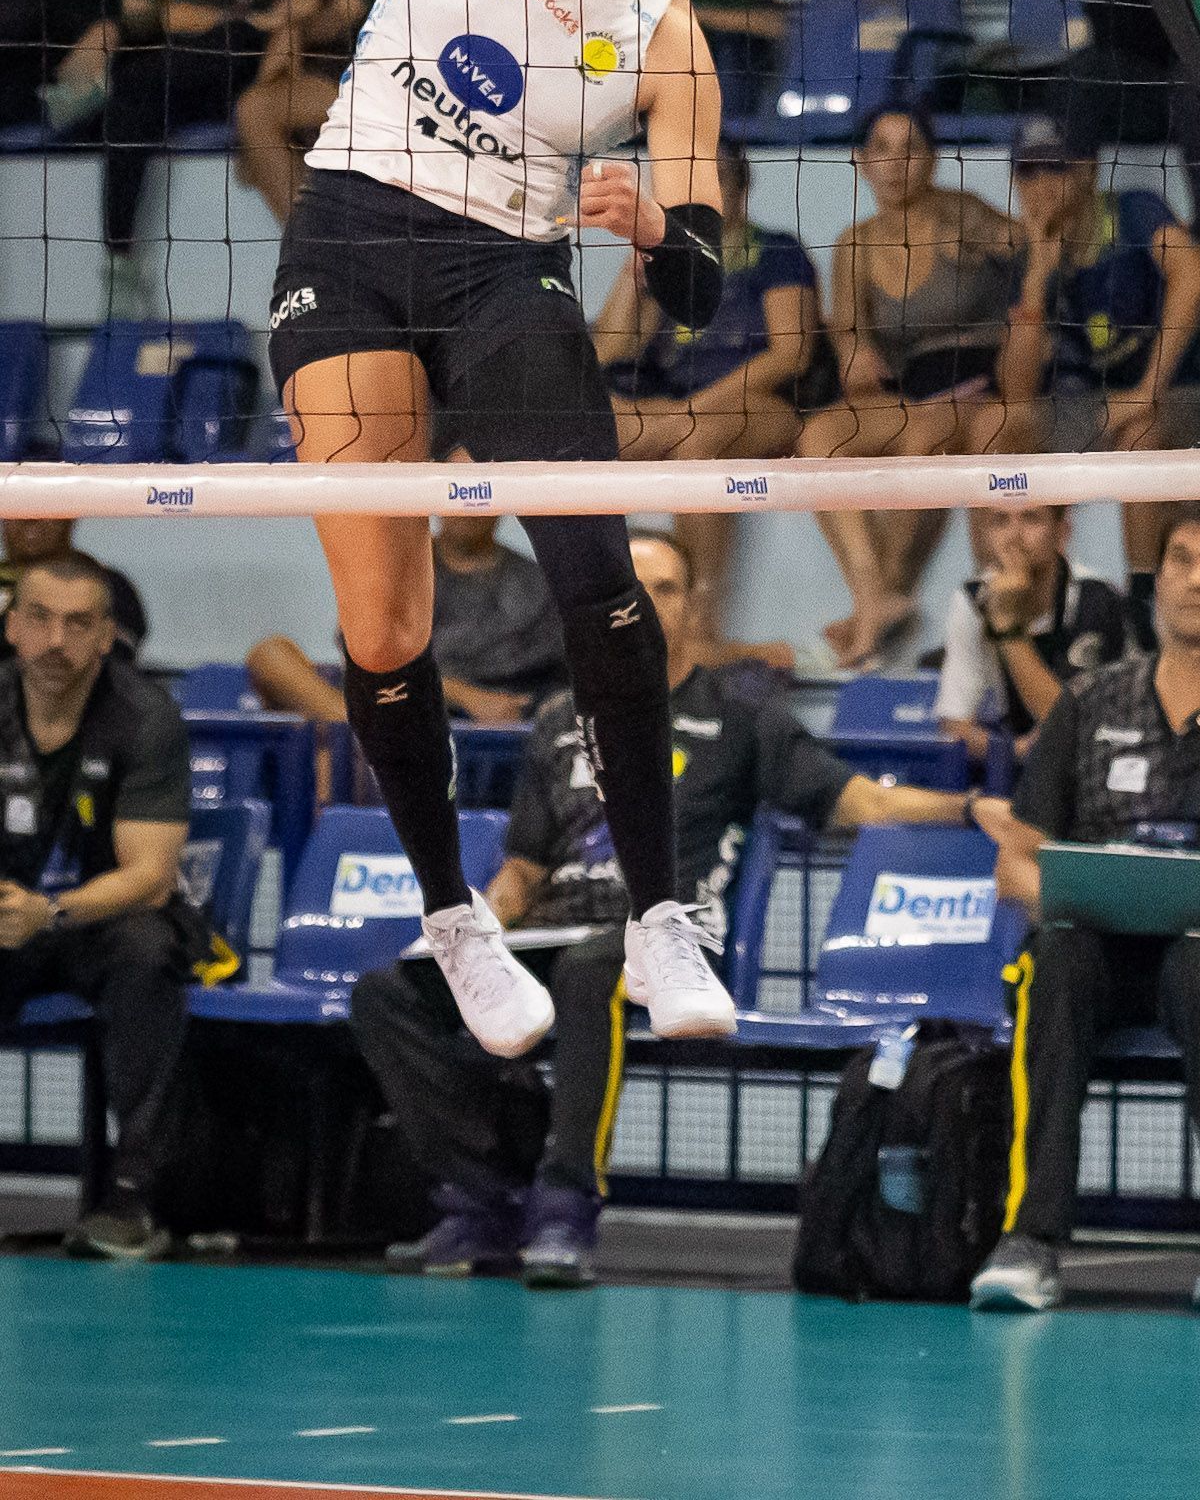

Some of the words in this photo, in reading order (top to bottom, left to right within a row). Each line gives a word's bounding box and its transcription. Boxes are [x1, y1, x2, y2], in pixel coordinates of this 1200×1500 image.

[448, 46, 505, 108] NIVEA
[448, 481, 492, 500] Dentil
[726, 476, 768, 494] Dentil
[989, 472, 1028, 490] Dentil
[146, 486, 194, 505] Dentil
[341, 864, 418, 895] Den
